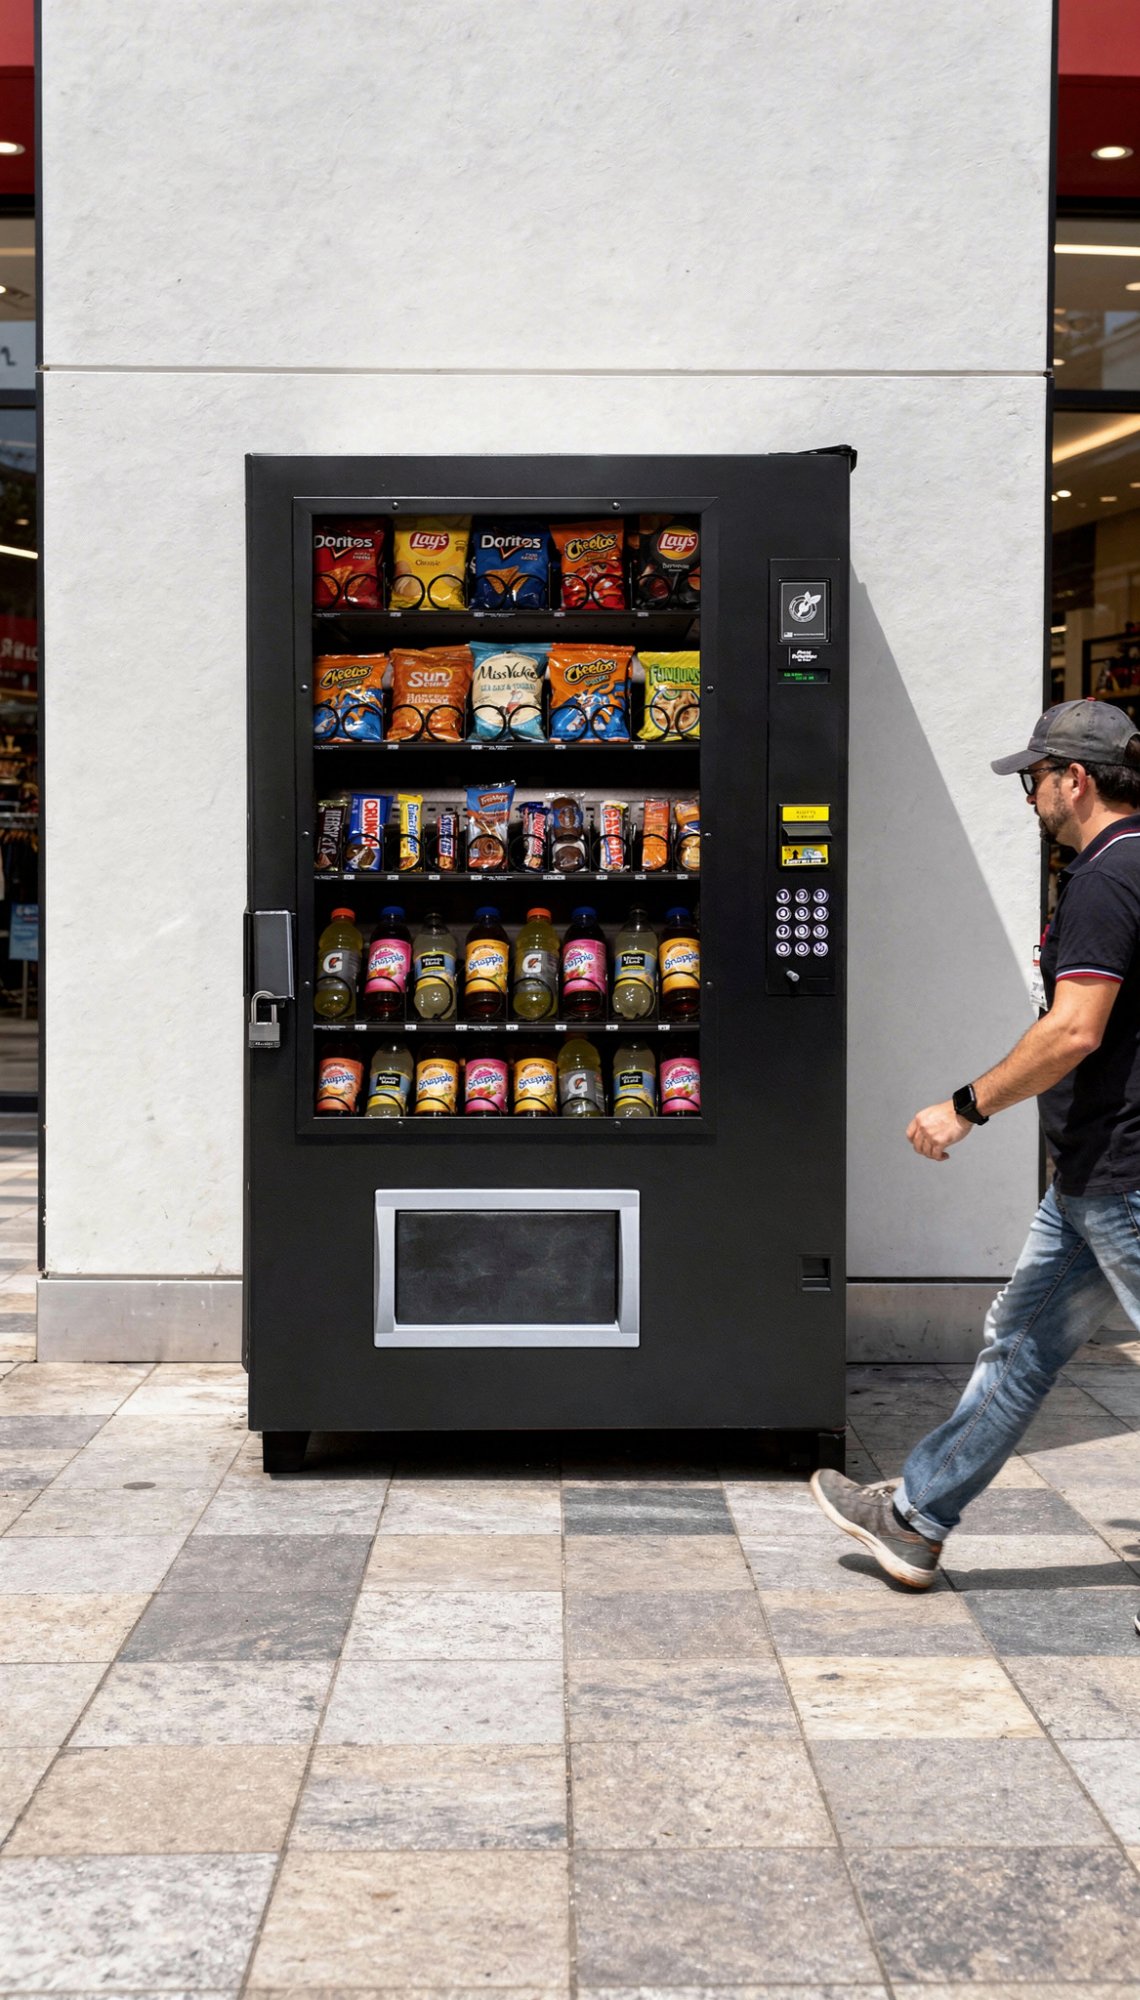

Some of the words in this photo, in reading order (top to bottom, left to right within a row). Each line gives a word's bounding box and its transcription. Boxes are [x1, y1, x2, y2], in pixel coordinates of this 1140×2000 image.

[315, 534, 373, 548] Doritos
[481, 534, 541, 549] Doritos
[566, 534, 617, 559] Cheetos
[321, 666, 370, 687] Cheetos
[407, 671, 449, 688] Sun
[566, 660, 616, 682] Cheetos
[323, 952, 343, 974] G
[469, 953, 504, 970] Snapple
[522, 953, 542, 974] G
[664, 950, 700, 970] Snapple
[418, 1072, 453, 1090] Snapple
[468, 1072, 503, 1090] Snapple
[518, 1071, 553, 1090] Snapple
[568, 1073, 588, 1095] G
[665, 1071, 700, 1090] Snapple
